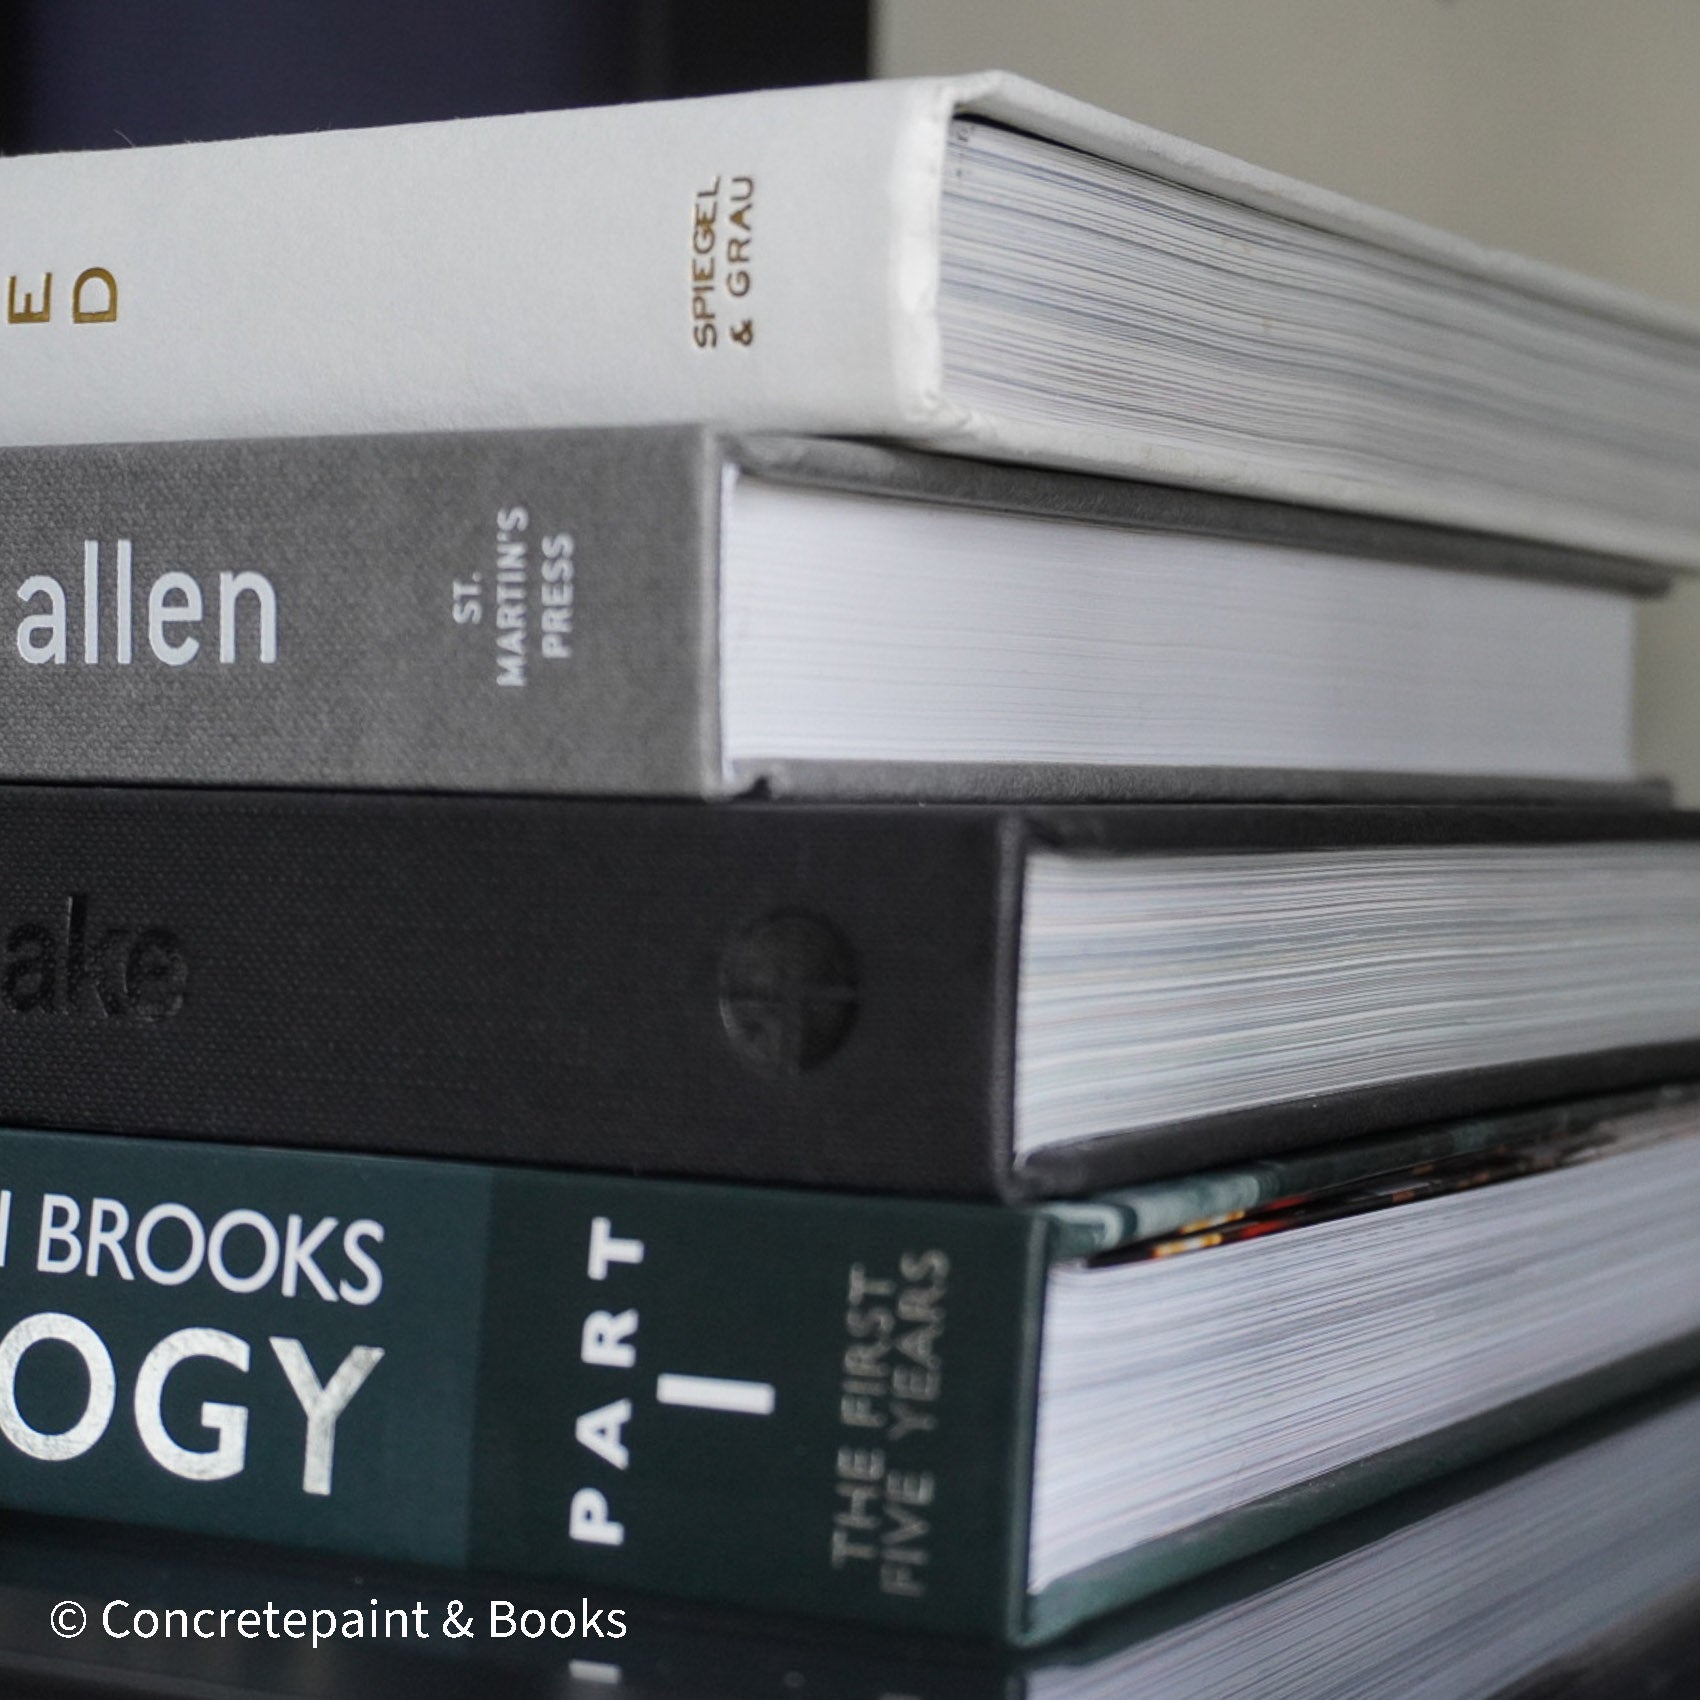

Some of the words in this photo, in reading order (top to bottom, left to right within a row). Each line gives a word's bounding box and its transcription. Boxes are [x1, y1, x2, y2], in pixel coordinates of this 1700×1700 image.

[692, 175, 721, 348] SPIEGEL
[726, 176, 755, 297] GRAU
[729, 319, 754, 346] &
[17, 539, 278, 666] allen
[452, 571, 483, 625] ST.
[496, 506, 529, 687] MARTIN'S
[541, 532, 575, 659] PRESS
[37, 1193, 385, 1306] BROOKS
[0, 1312, 385, 1496] OGY
[569, 1217, 645, 1547] PART
[840, 1262, 896, 1429] FIRST
[886, 1249, 950, 1441] YEARS
[831, 1448, 885, 1568] THE
[880, 1468, 936, 1597] FIVE
